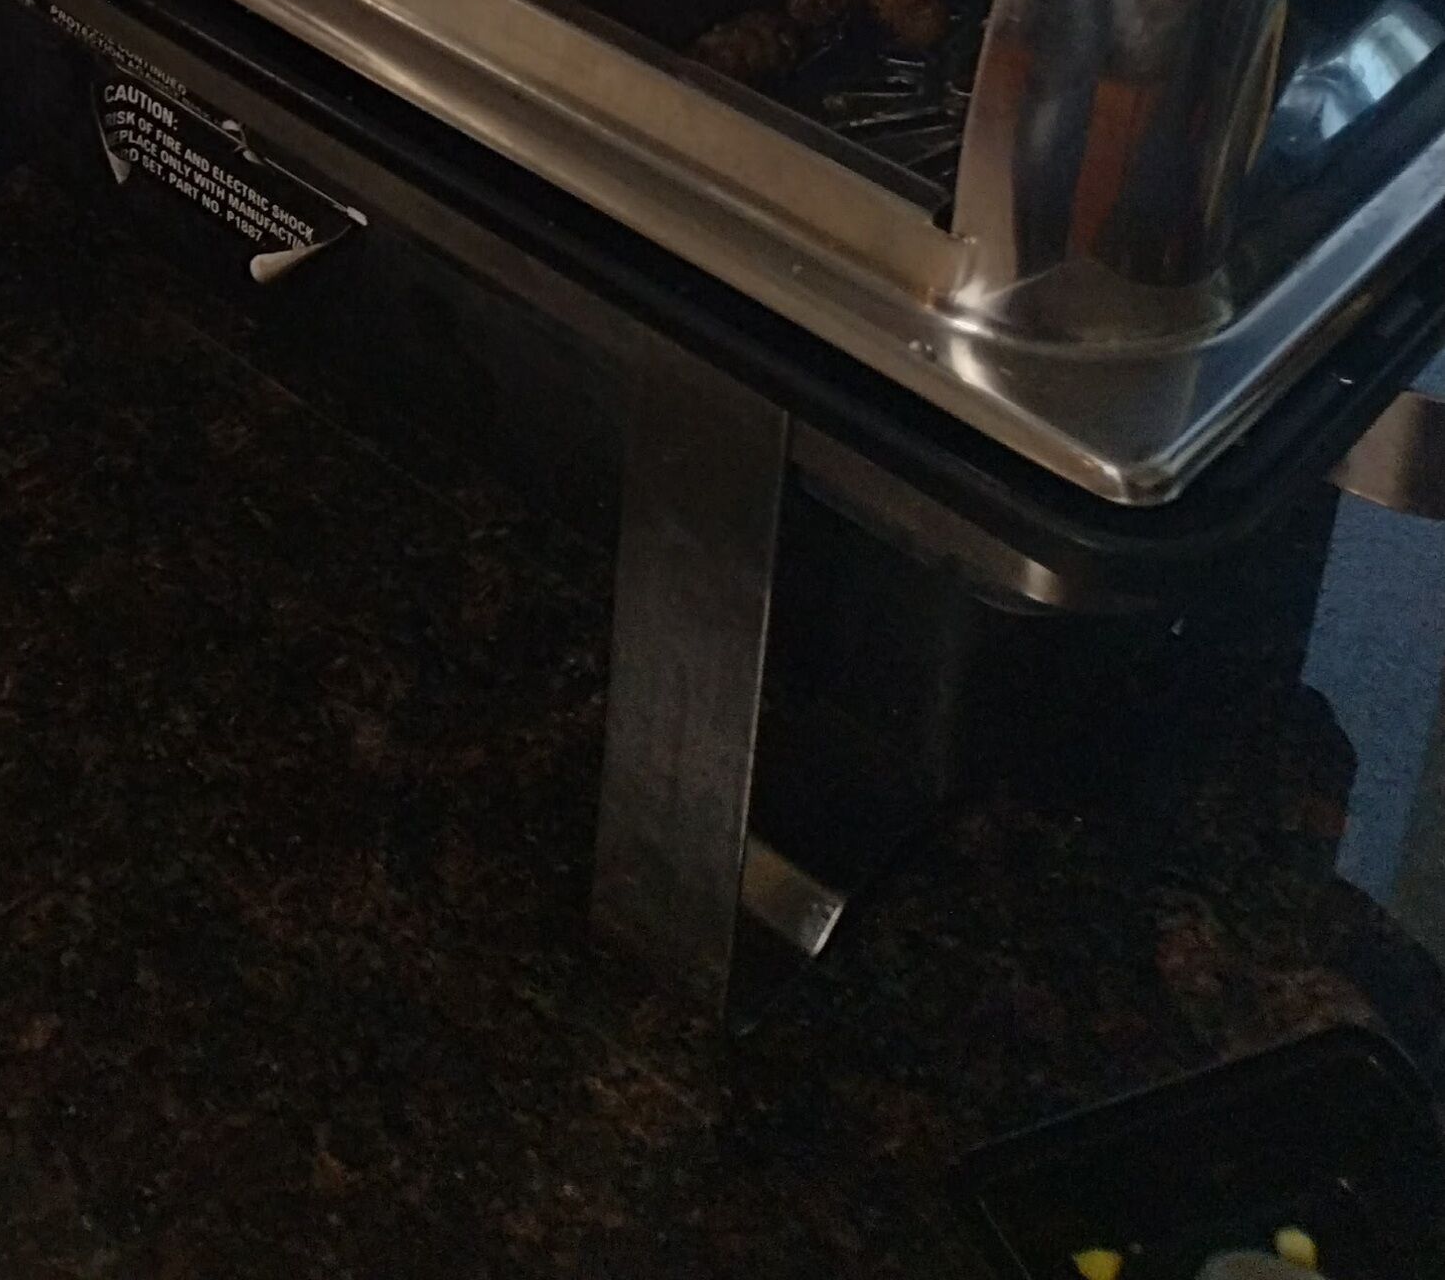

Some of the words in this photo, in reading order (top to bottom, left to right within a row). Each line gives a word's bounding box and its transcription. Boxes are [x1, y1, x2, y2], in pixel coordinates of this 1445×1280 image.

[105, 83, 179, 131] CAUTION:
[140, 118, 154, 134] OF
[156, 129, 182, 156] FIRE
[184, 149, 209, 173] AND
[214, 165, 268, 211] ELECTRIC
[162, 150, 193, 176] ONLY
[193, 171, 225, 200] WITH
[169, 172, 199, 200] PART
